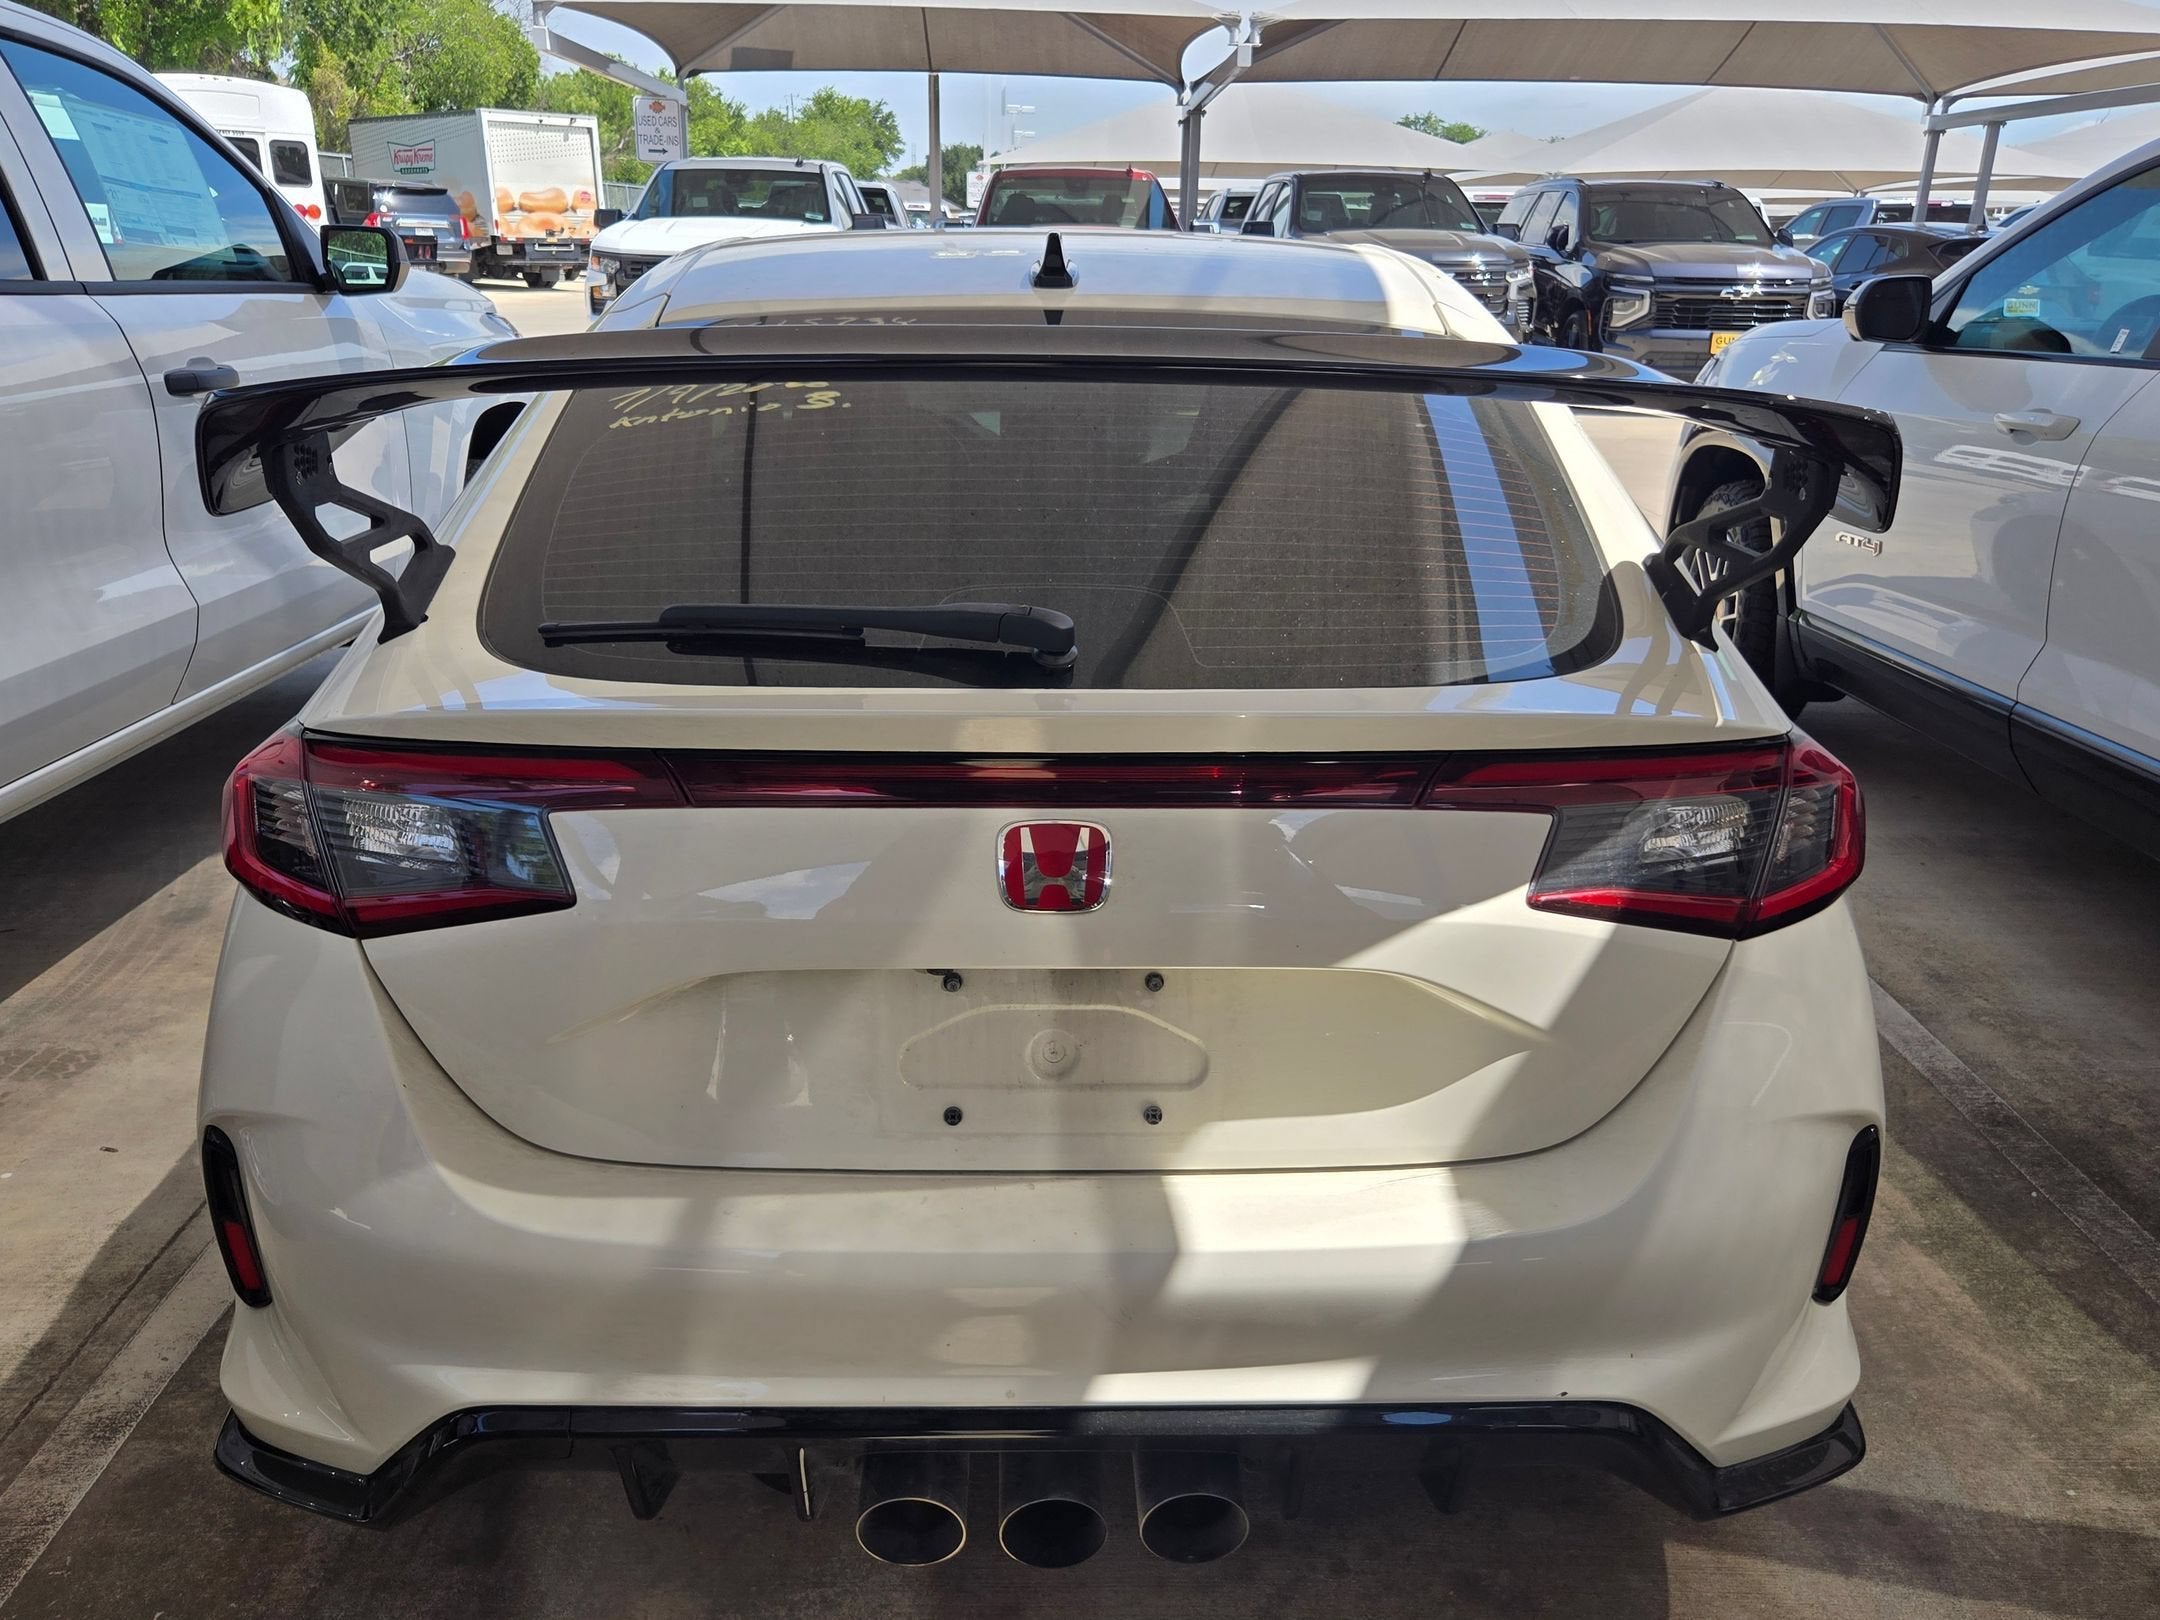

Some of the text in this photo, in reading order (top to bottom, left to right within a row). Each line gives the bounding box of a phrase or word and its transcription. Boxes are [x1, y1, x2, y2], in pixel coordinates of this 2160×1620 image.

[638, 114, 678, 128] USED CARS
[637, 133, 680, 146] TRADE-INS
